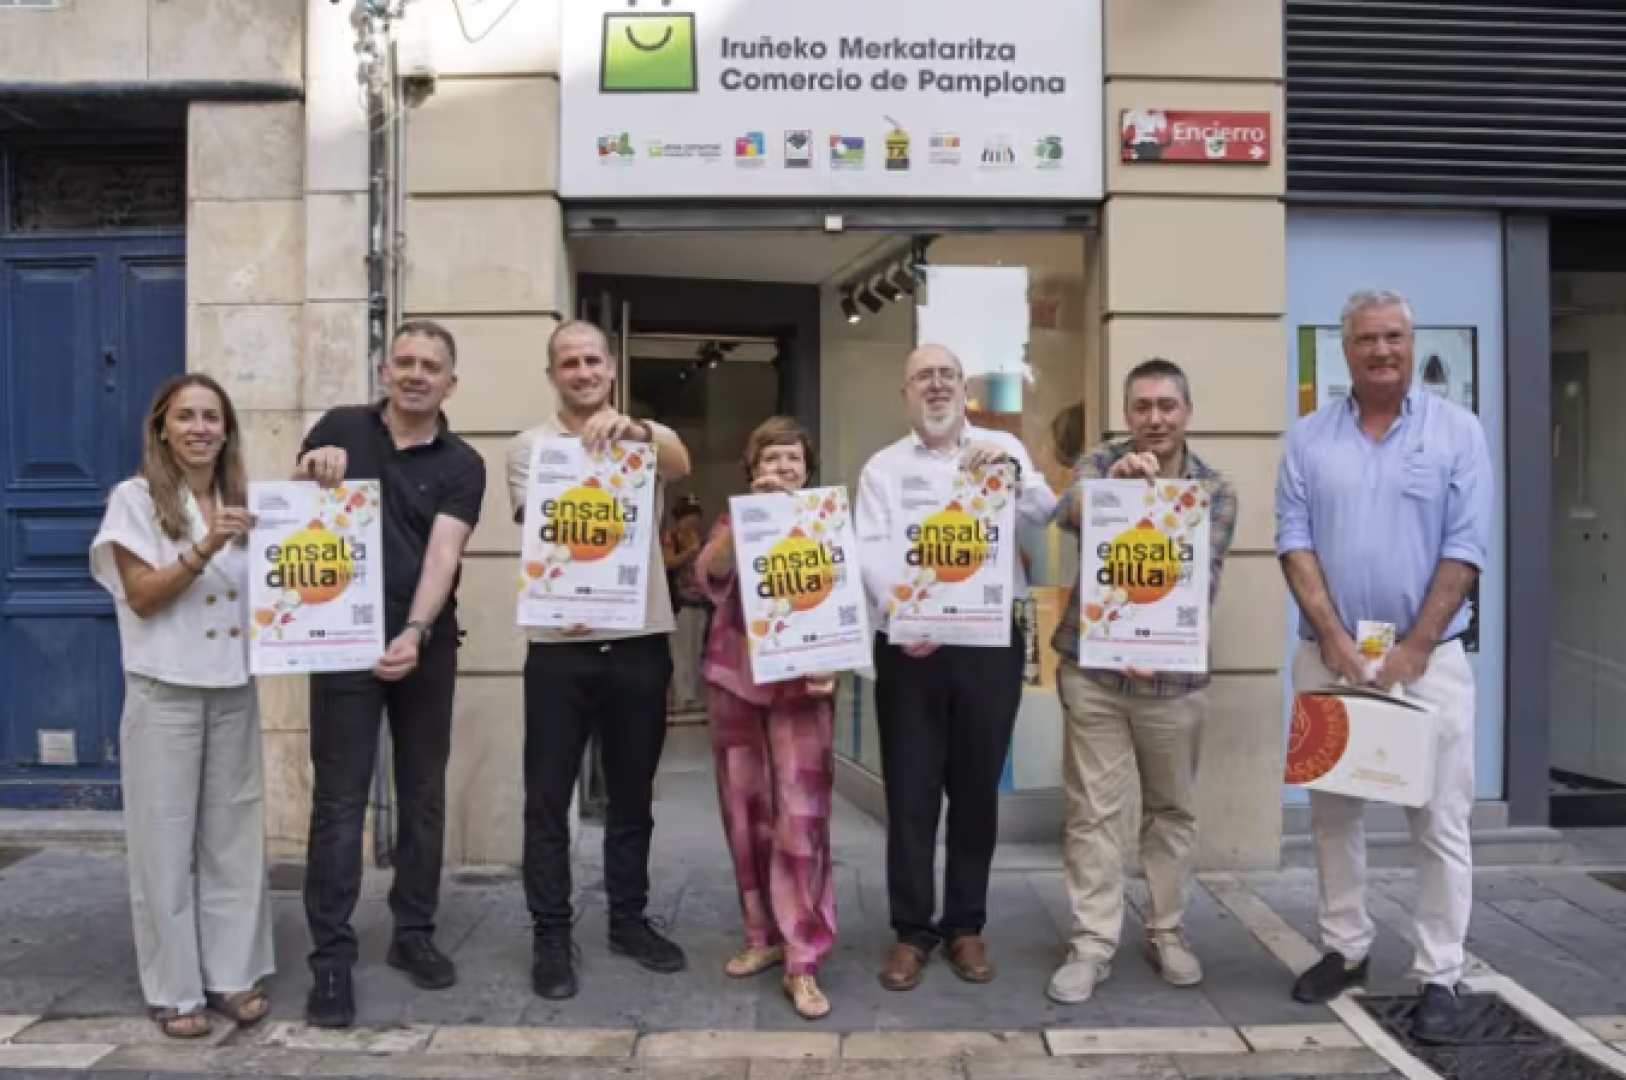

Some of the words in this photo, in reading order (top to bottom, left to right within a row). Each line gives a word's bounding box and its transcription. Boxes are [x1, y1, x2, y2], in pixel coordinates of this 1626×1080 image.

[720, 36, 828, 61] Iruñeko
[839, 37, 1016, 62] Merkataritza
[720, 68, 862, 92] Comercio
[870, 69, 908, 92] de
[919, 70, 1065, 97] Pamplona
[540, 496, 638, 523] ensala
[539, 519, 608, 546] dilla
[906, 520, 999, 542] ensala
[265, 536, 367, 562] ensala
[752, 542, 845, 573] ensala
[905, 543, 970, 567] dilla
[1096, 536, 1194, 562] ensala
[266, 562, 338, 587] dilla
[756, 569, 821, 598] dilla
[1096, 562, 1164, 588] dilla
